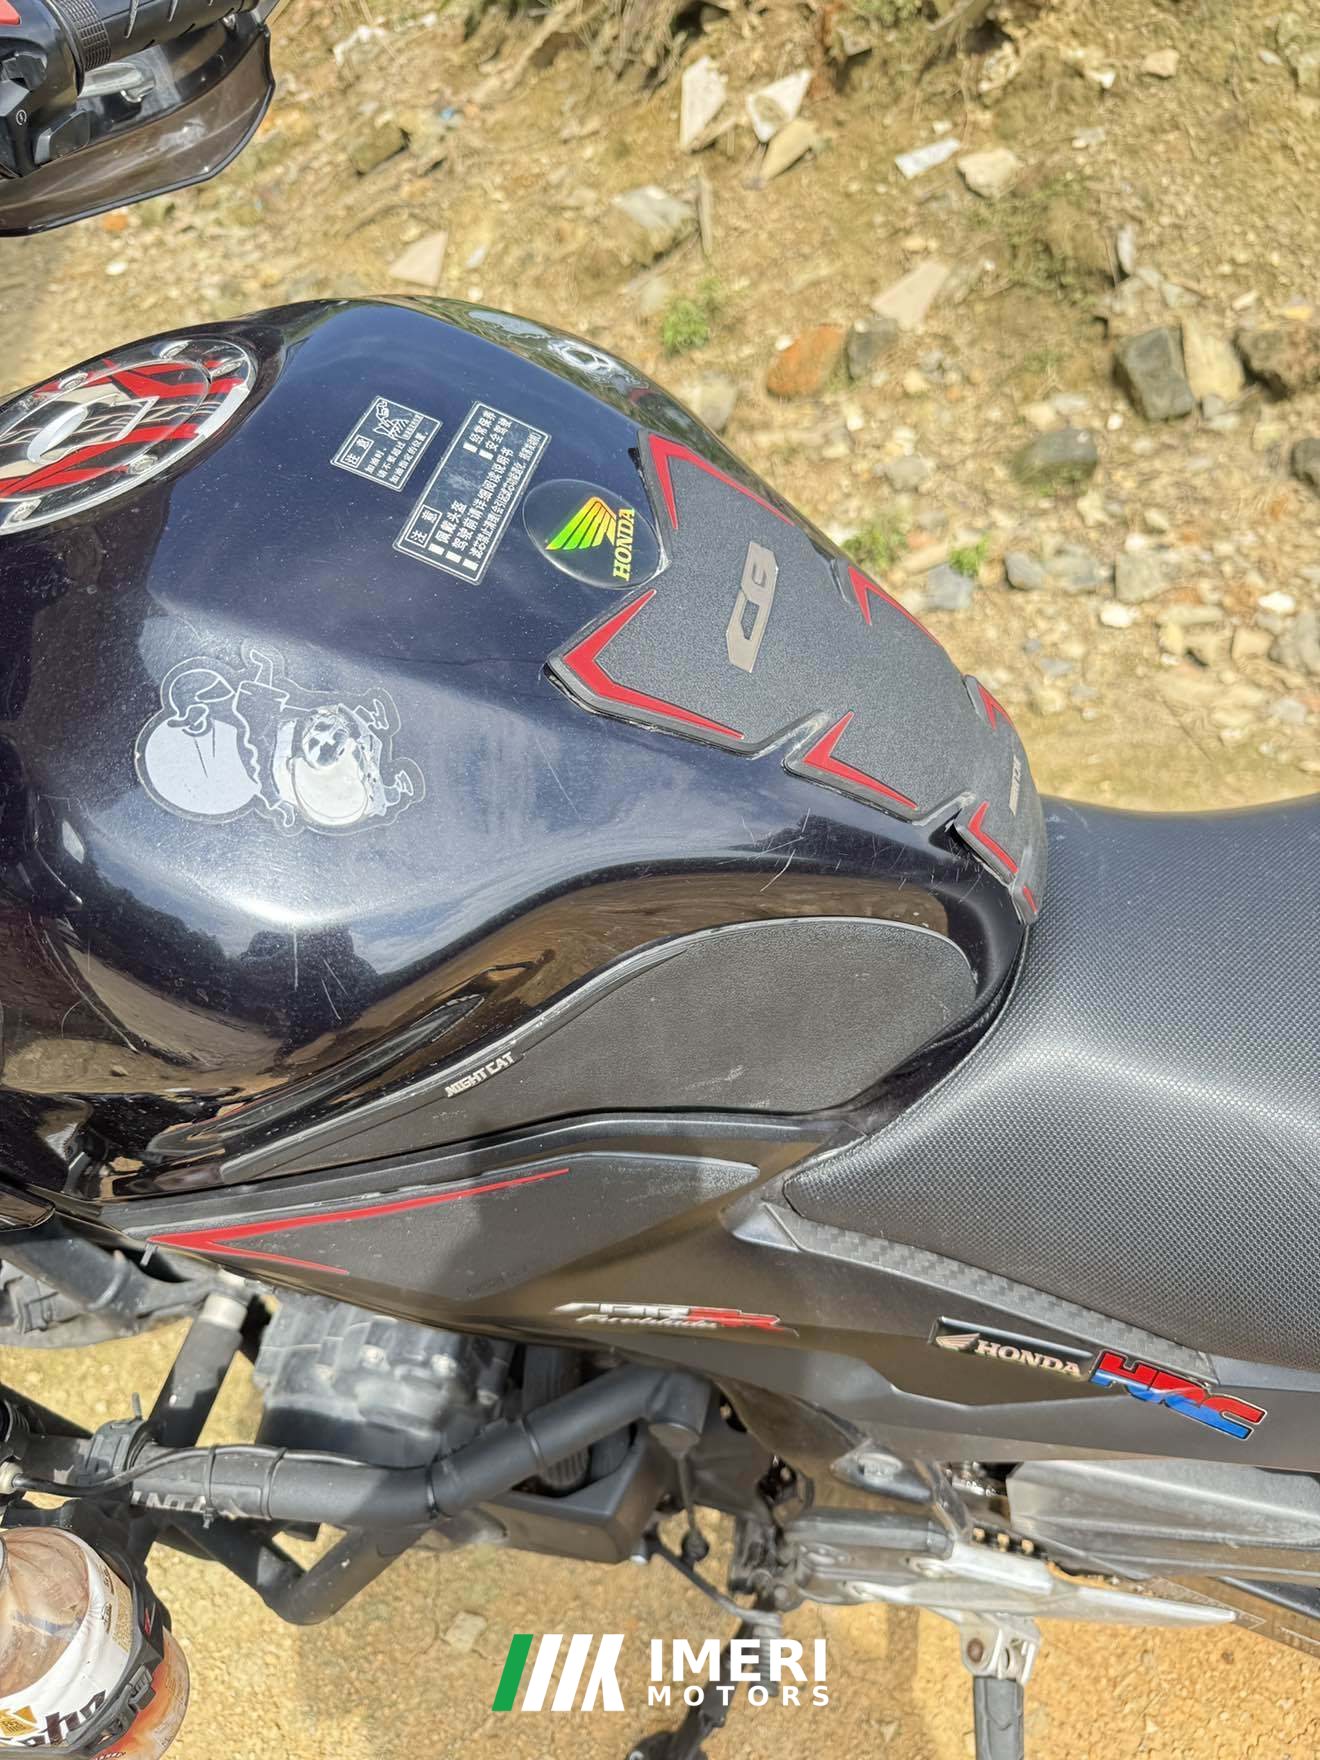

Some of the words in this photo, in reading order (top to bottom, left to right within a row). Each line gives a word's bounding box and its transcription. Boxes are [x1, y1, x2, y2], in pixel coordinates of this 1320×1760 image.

[612, 508, 636, 582] HONDA
[485, 1051, 515, 1075] CAT
[974, 1339, 1081, 1377] HONDA
[1088, 1348, 1267, 1441] HRC
